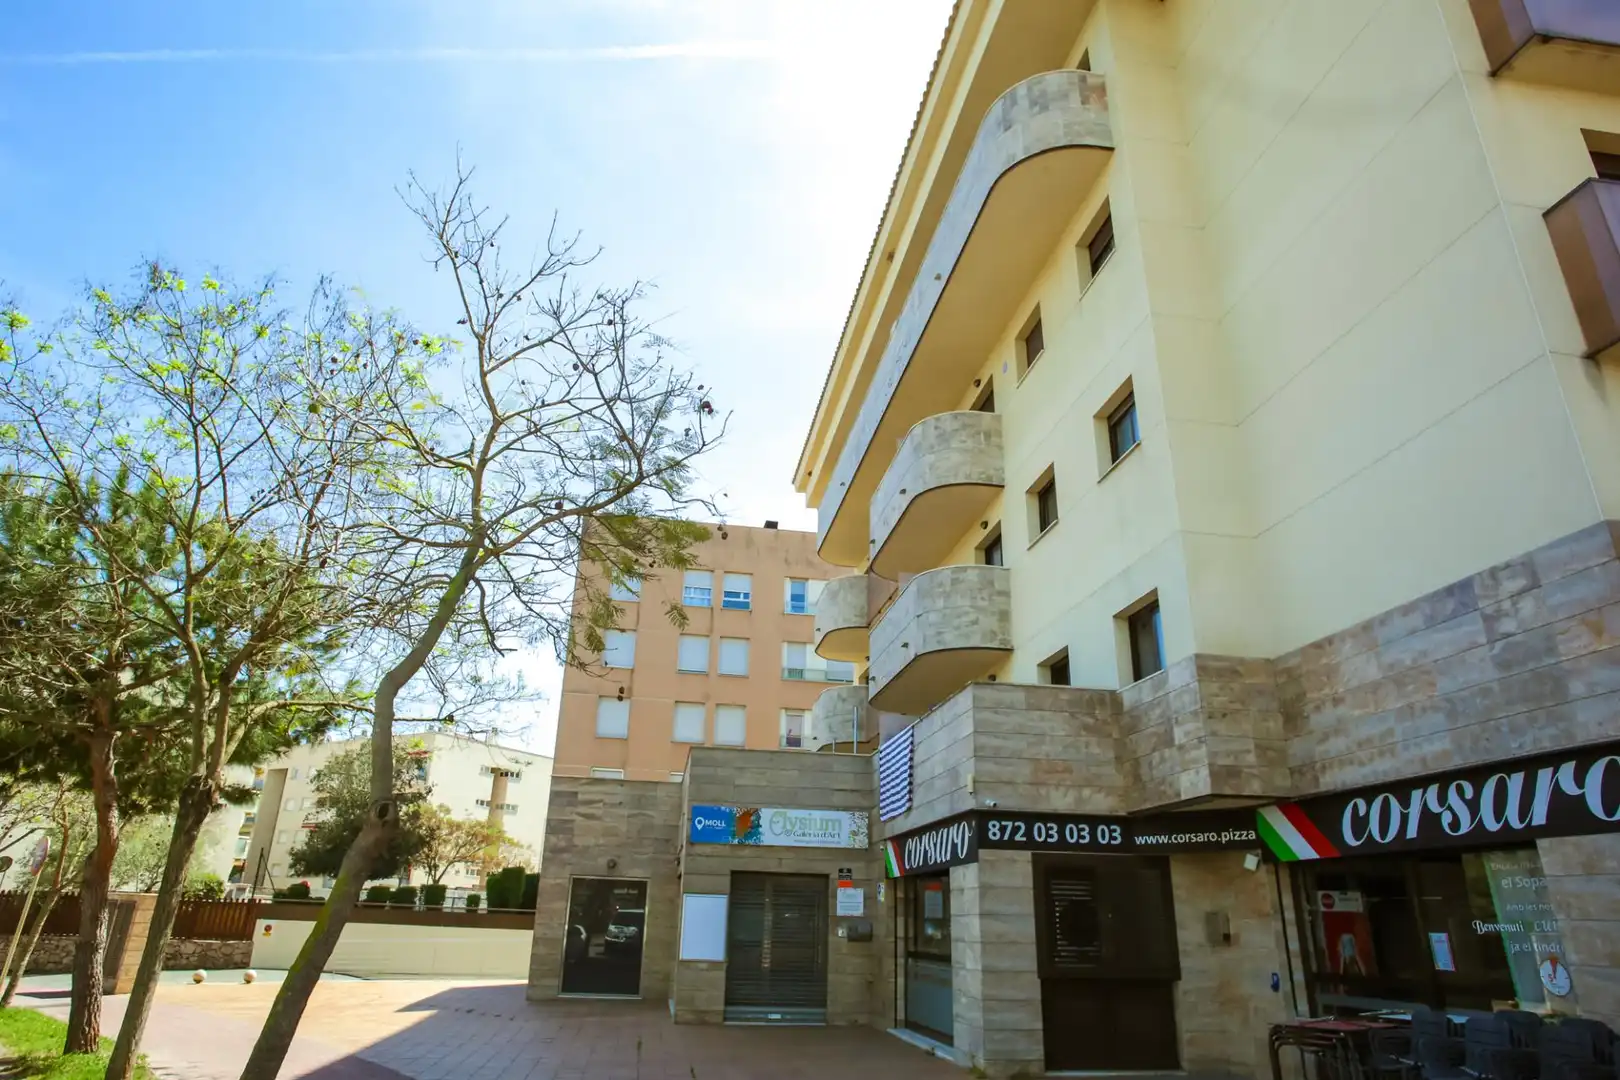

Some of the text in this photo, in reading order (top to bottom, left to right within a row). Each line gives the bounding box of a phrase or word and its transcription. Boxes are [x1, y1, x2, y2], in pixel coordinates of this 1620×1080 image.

[1342, 755, 1620, 847] corsaro
[705, 819, 726, 827] MOLL
[769, 811, 842, 836] Elysium
[988, 820, 1122, 845] 872 03 03 03
[904, 820, 975, 870] corsaro
[1134, 828, 1256, 845] www.corsaro.pizza
[1472, 920, 1524, 935] Benvenuti
